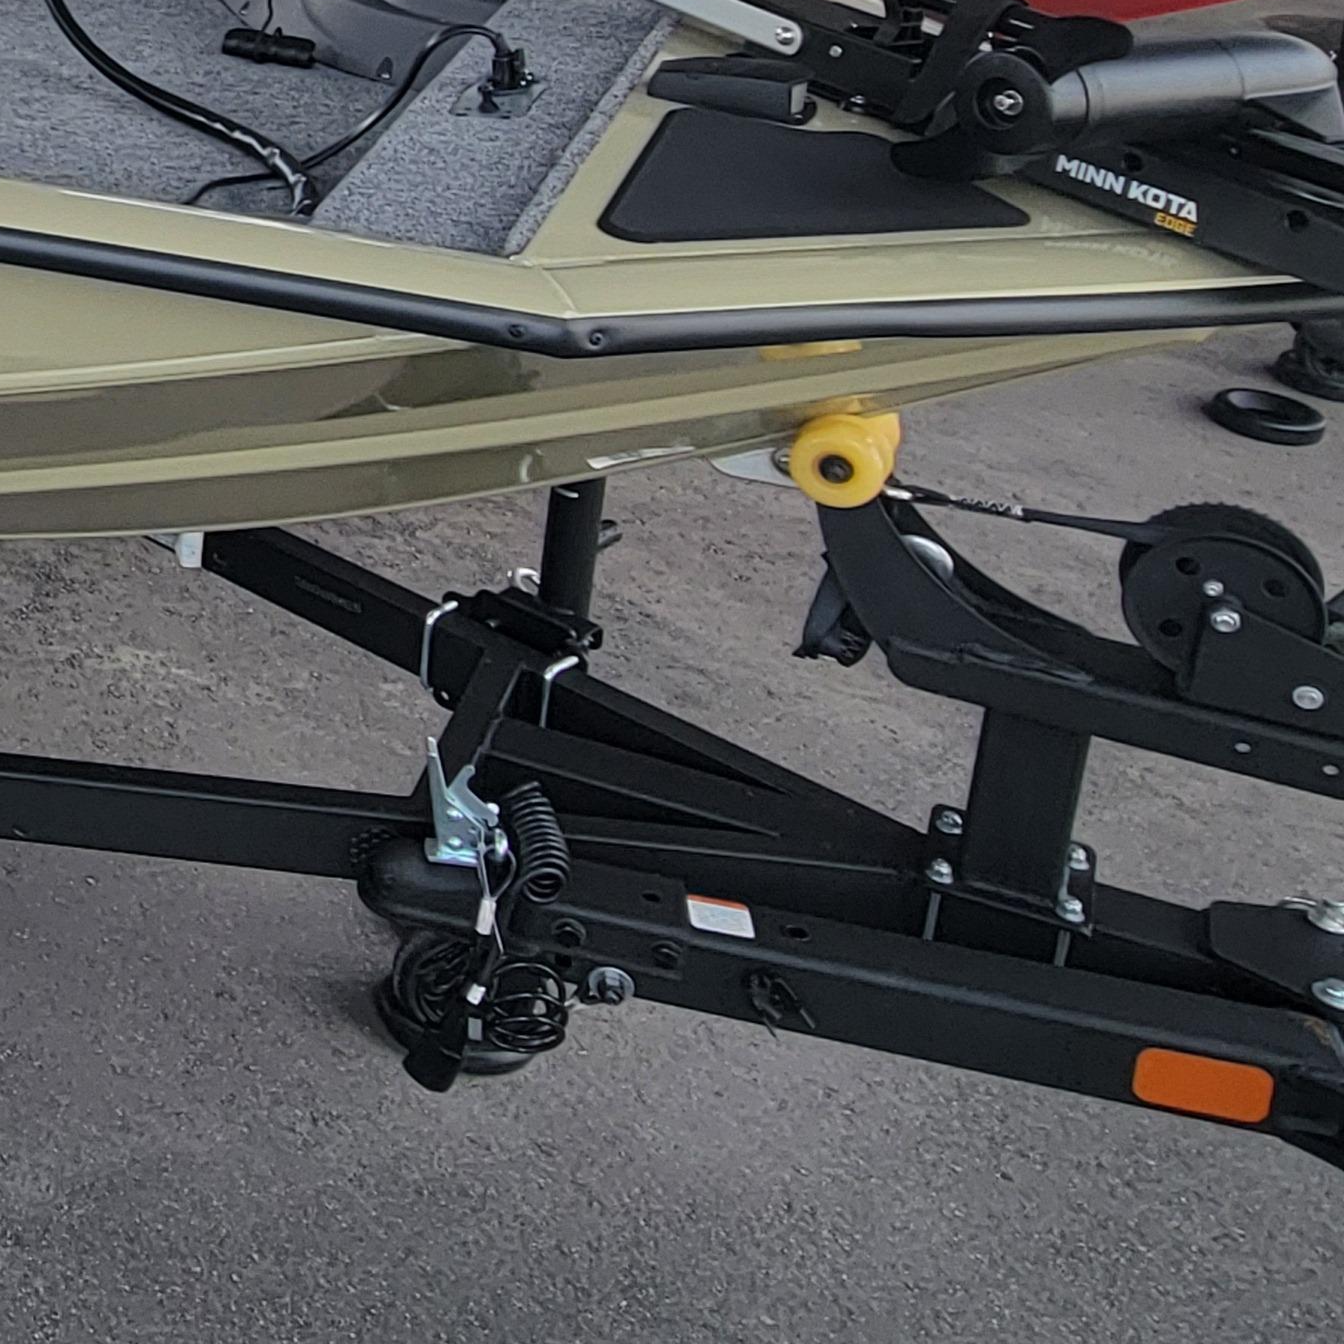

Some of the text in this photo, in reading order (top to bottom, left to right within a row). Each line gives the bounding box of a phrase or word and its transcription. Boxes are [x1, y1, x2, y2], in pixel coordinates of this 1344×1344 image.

[1055, 154, 1199, 224] MINN KOTA
[1153, 211, 1199, 239] EDGE
